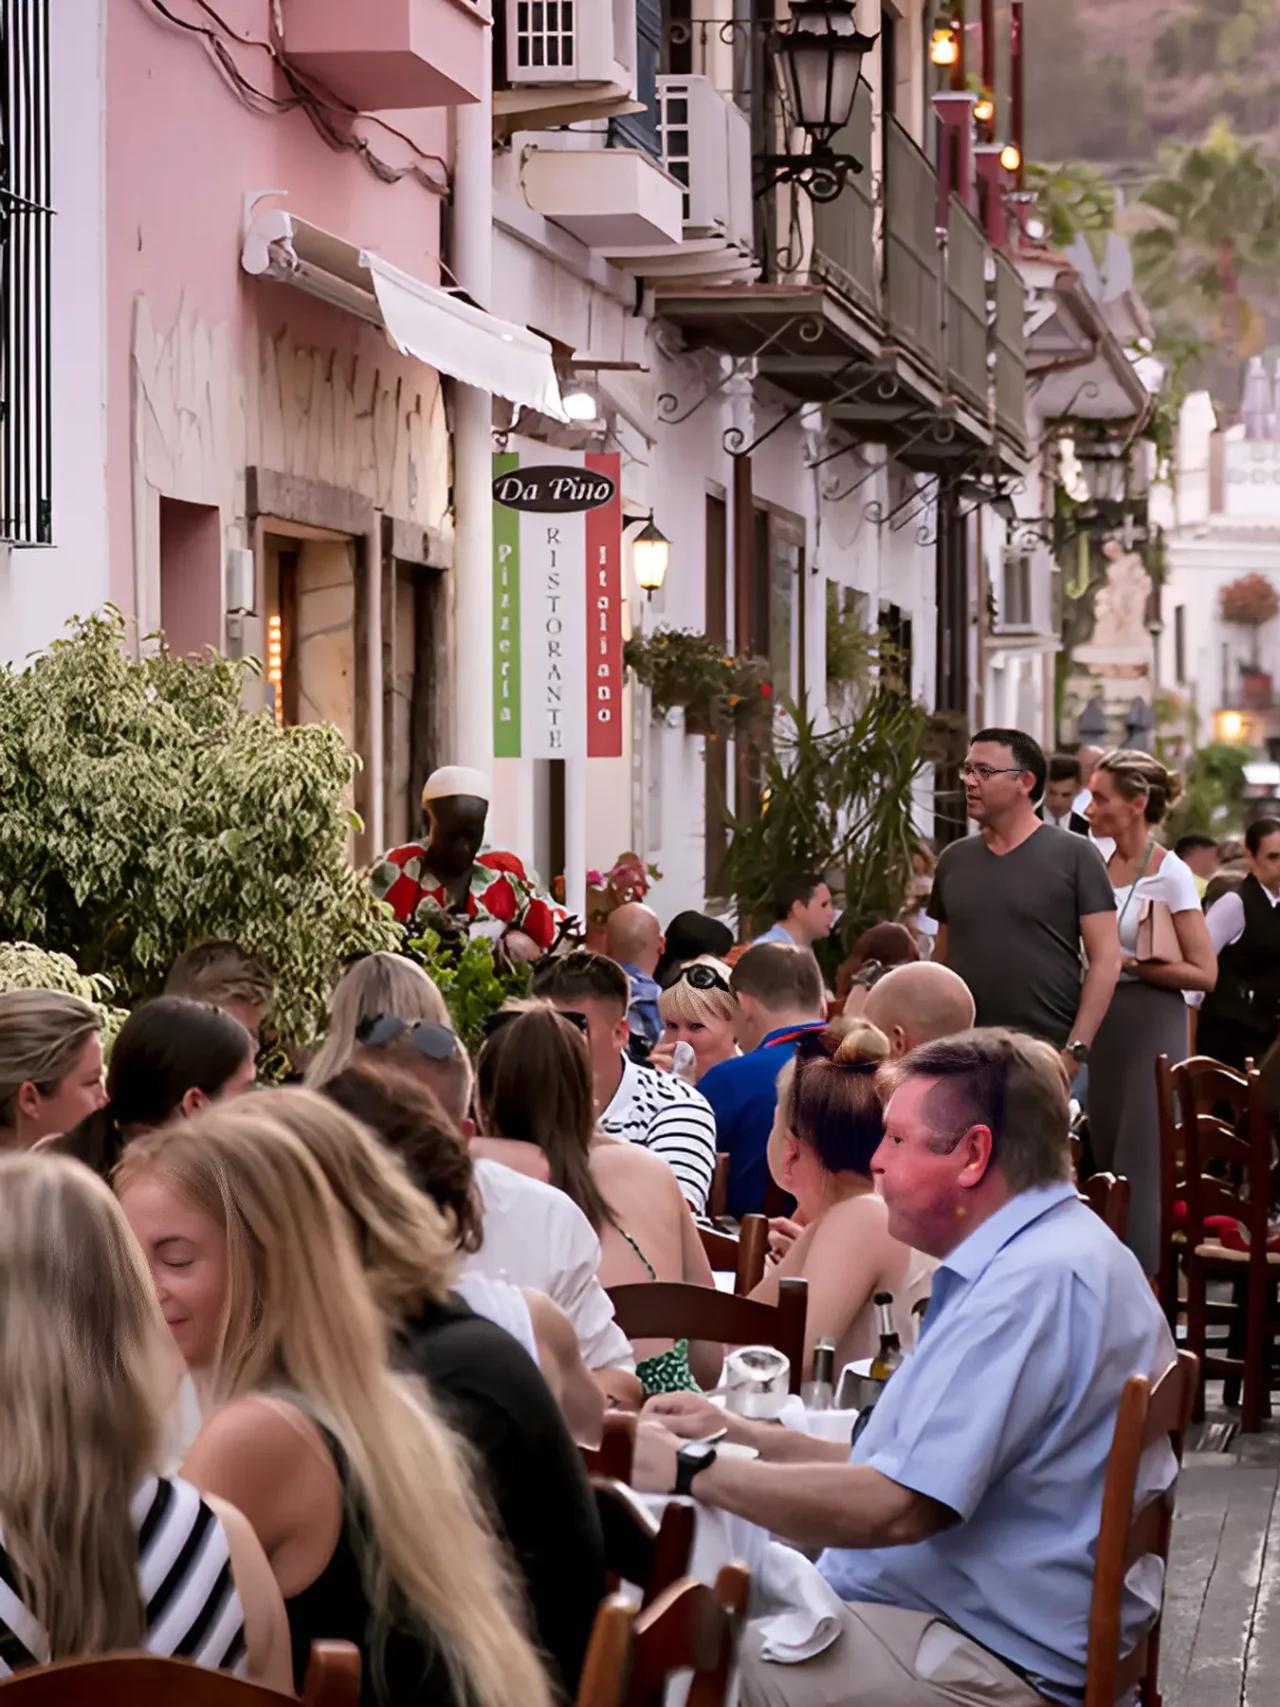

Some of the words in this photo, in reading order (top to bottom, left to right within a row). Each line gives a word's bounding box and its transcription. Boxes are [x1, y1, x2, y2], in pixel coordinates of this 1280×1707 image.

[497, 477, 539, 501] Da
[548, 475, 611, 501] Pino
[545, 527, 563, 749] RISTORANTE
[596, 545, 612, 723] Italiano
